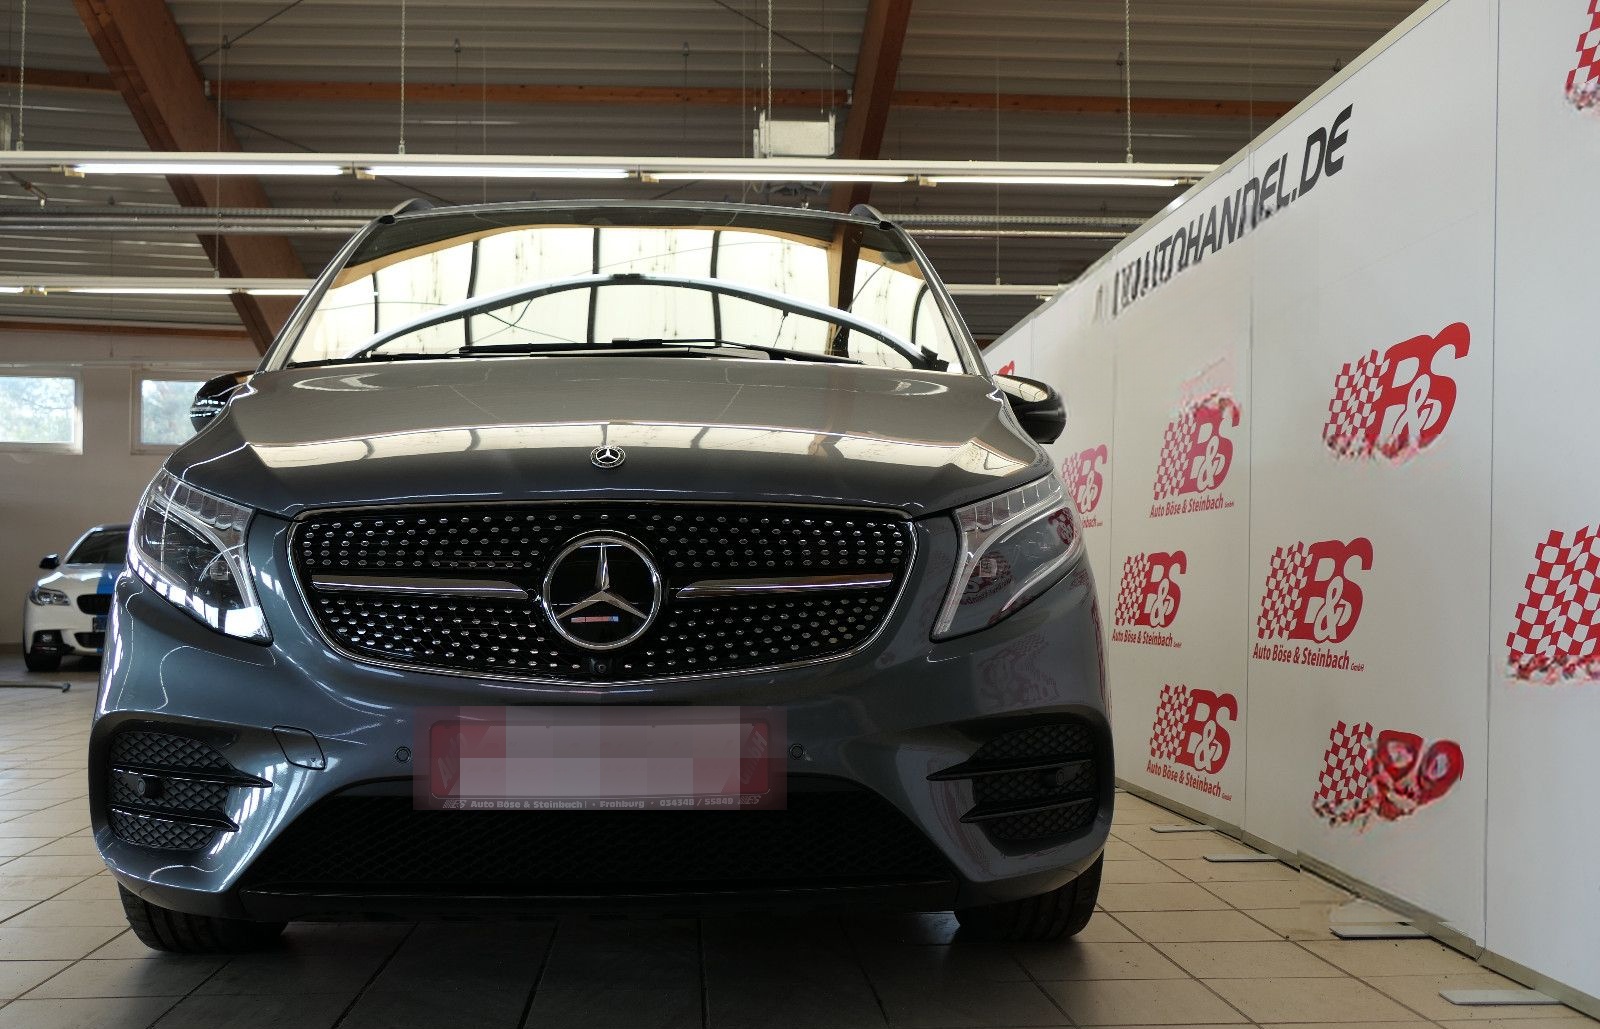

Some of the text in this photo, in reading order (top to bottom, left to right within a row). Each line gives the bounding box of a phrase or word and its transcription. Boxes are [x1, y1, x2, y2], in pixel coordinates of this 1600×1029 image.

[1149, 504, 1165, 518] Auto
[1165, 501, 1181, 516] Böse
[1188, 492, 1224, 513] Steinbach
[1111, 628, 1125, 642] Auto
[1124, 629, 1137, 643] Böse
[1142, 631, 1173, 648] Steinbach
[1252, 643, 1271, 660] Auto
[1271, 643, 1292, 663] Böse
[1292, 646, 1300, 664] &
[1301, 646, 1350, 670] Steinbach
[1146, 760, 1161, 776] Auto
[1162, 764, 1178, 782] Böse
[1179, 769, 1185, 785] &
[1185, 772, 1221, 798] Steinbach
[470, 800, 495, 808] Auto
[496, 799, 521, 809] Böse
[523, 800, 531, 808] &
[600, 799, 645, 809] Frohburg
